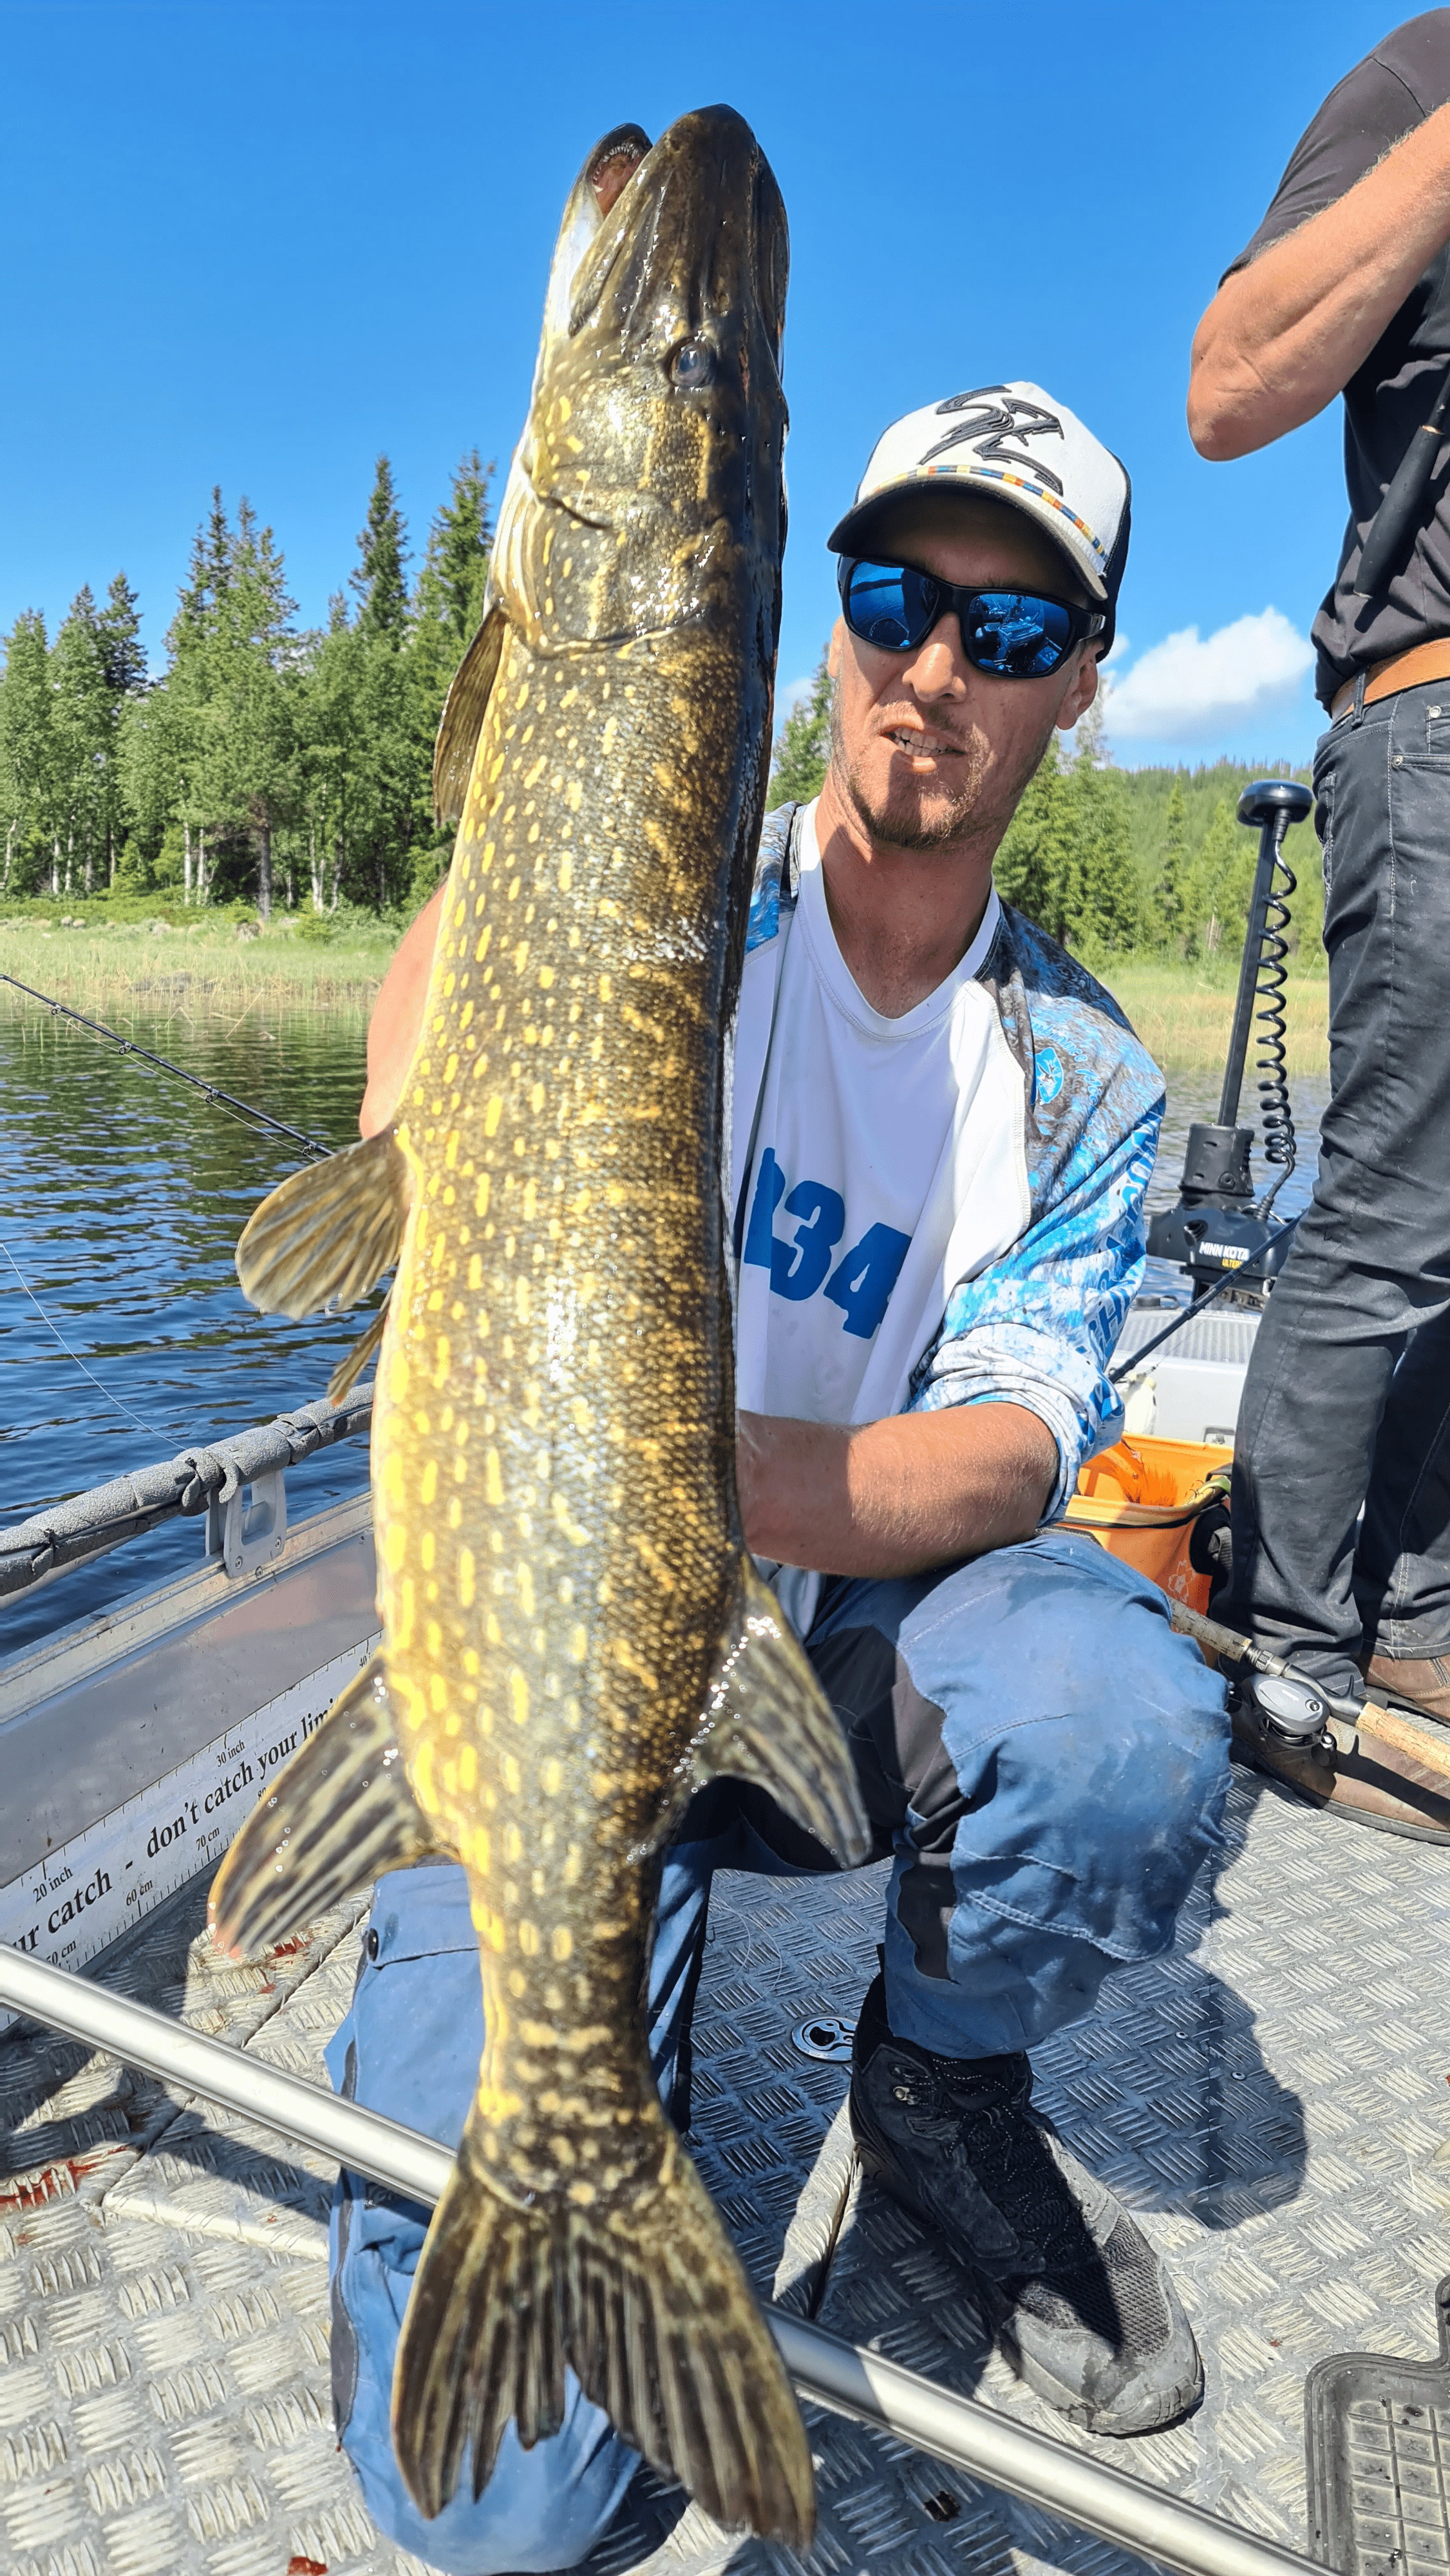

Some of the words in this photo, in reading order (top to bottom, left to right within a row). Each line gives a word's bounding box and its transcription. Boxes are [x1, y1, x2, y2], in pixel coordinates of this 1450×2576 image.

[1199, 1241, 1223, 1258] MINN
[1223, 1245, 1250, 1262] KOTA
[216, 1752, 226, 1767] 30
[228, 1739, 245, 1759] inch
[48, 1868, 112, 1934] catch
[147, 1802, 199, 1858] don't
[204, 1761, 254, 1814] catch
[258, 1731, 297, 1780] your
[196, 1835, 207, 1851] 70
[207, 1827, 220, 1842] cm
[33, 1883, 48, 1903] 20
[48, 1866, 73, 1891] inch
[126, 1888, 137, 1906] 60
[139, 1880, 153, 1895] cm
[61, 1940, 77, 1958] cm
